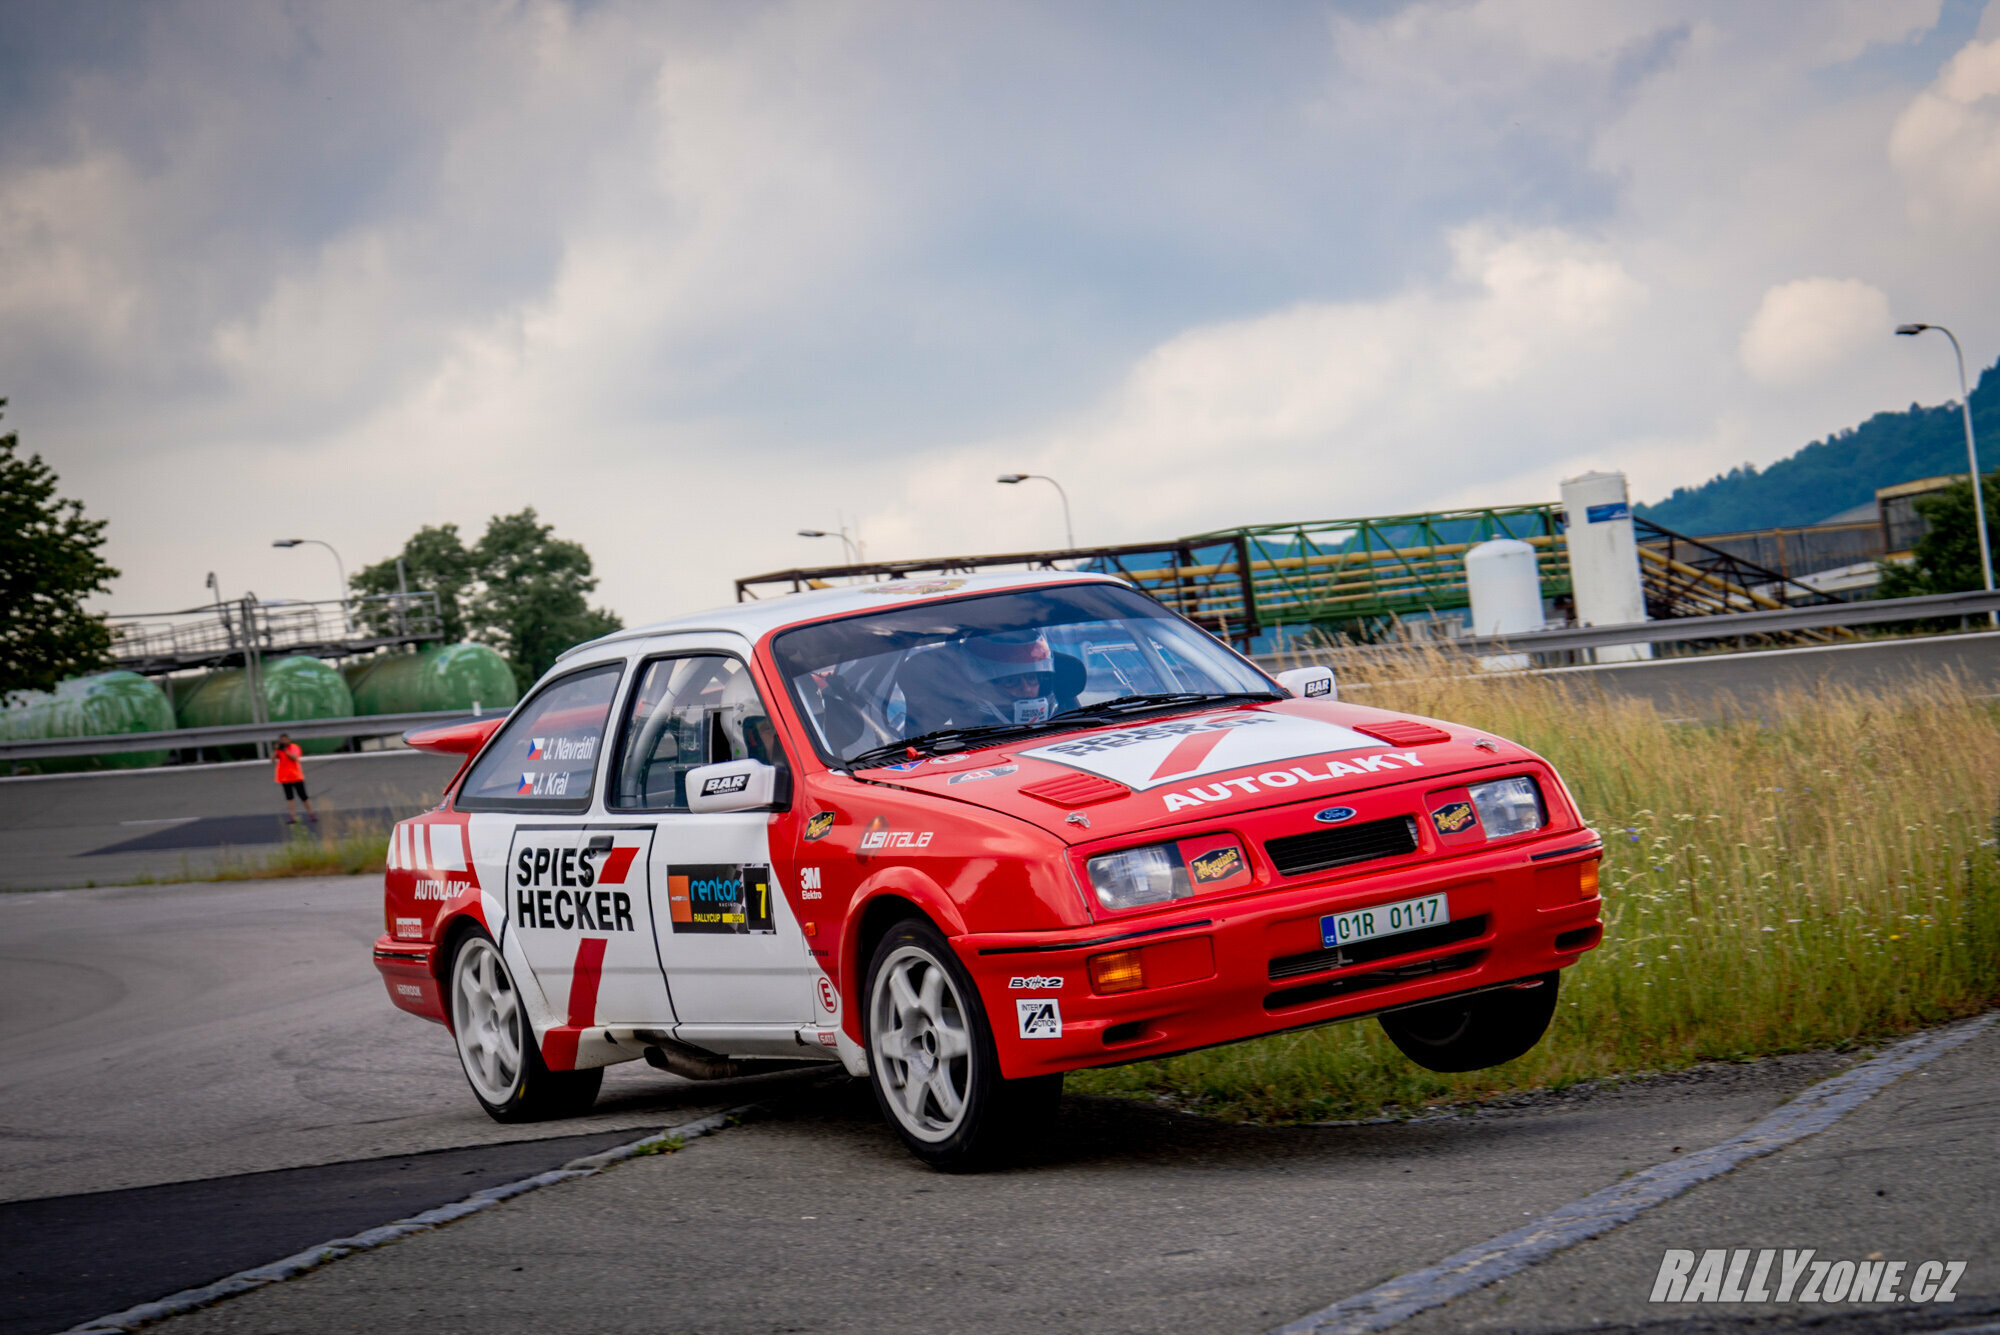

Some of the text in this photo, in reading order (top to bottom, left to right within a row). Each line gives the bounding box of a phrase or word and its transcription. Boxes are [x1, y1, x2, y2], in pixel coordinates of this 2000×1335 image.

[1307, 680, 1329, 694] BAR
[543, 736, 596, 760] J. Navrátil
[1047, 721, 1201, 753] SPIES
[1059, 717, 1277, 757] HECKER
[533, 772, 570, 795] J. Král
[706, 774, 744, 792] BAR
[1162, 752, 1425, 812] AUTOLAKY
[516, 847, 594, 888] SPIES
[801, 867, 821, 890] 3M
[414, 880, 471, 901] AUTOLAKY
[690, 875, 741, 902] rentor
[802, 890, 822, 900] Elektro
[517, 890, 635, 932] HECKER
[756, 883, 767, 919] 7
[694, 913, 721, 923] RALLYCUP
[732, 914, 744, 923] 2021
[1338, 899, 1438, 939] 01R 0117
[1325, 935, 1336, 944] CZ
[820, 983, 834, 1008] E
[1033, 1019, 1057, 1027] ACTION
[820, 1033, 836, 1045] SATA
